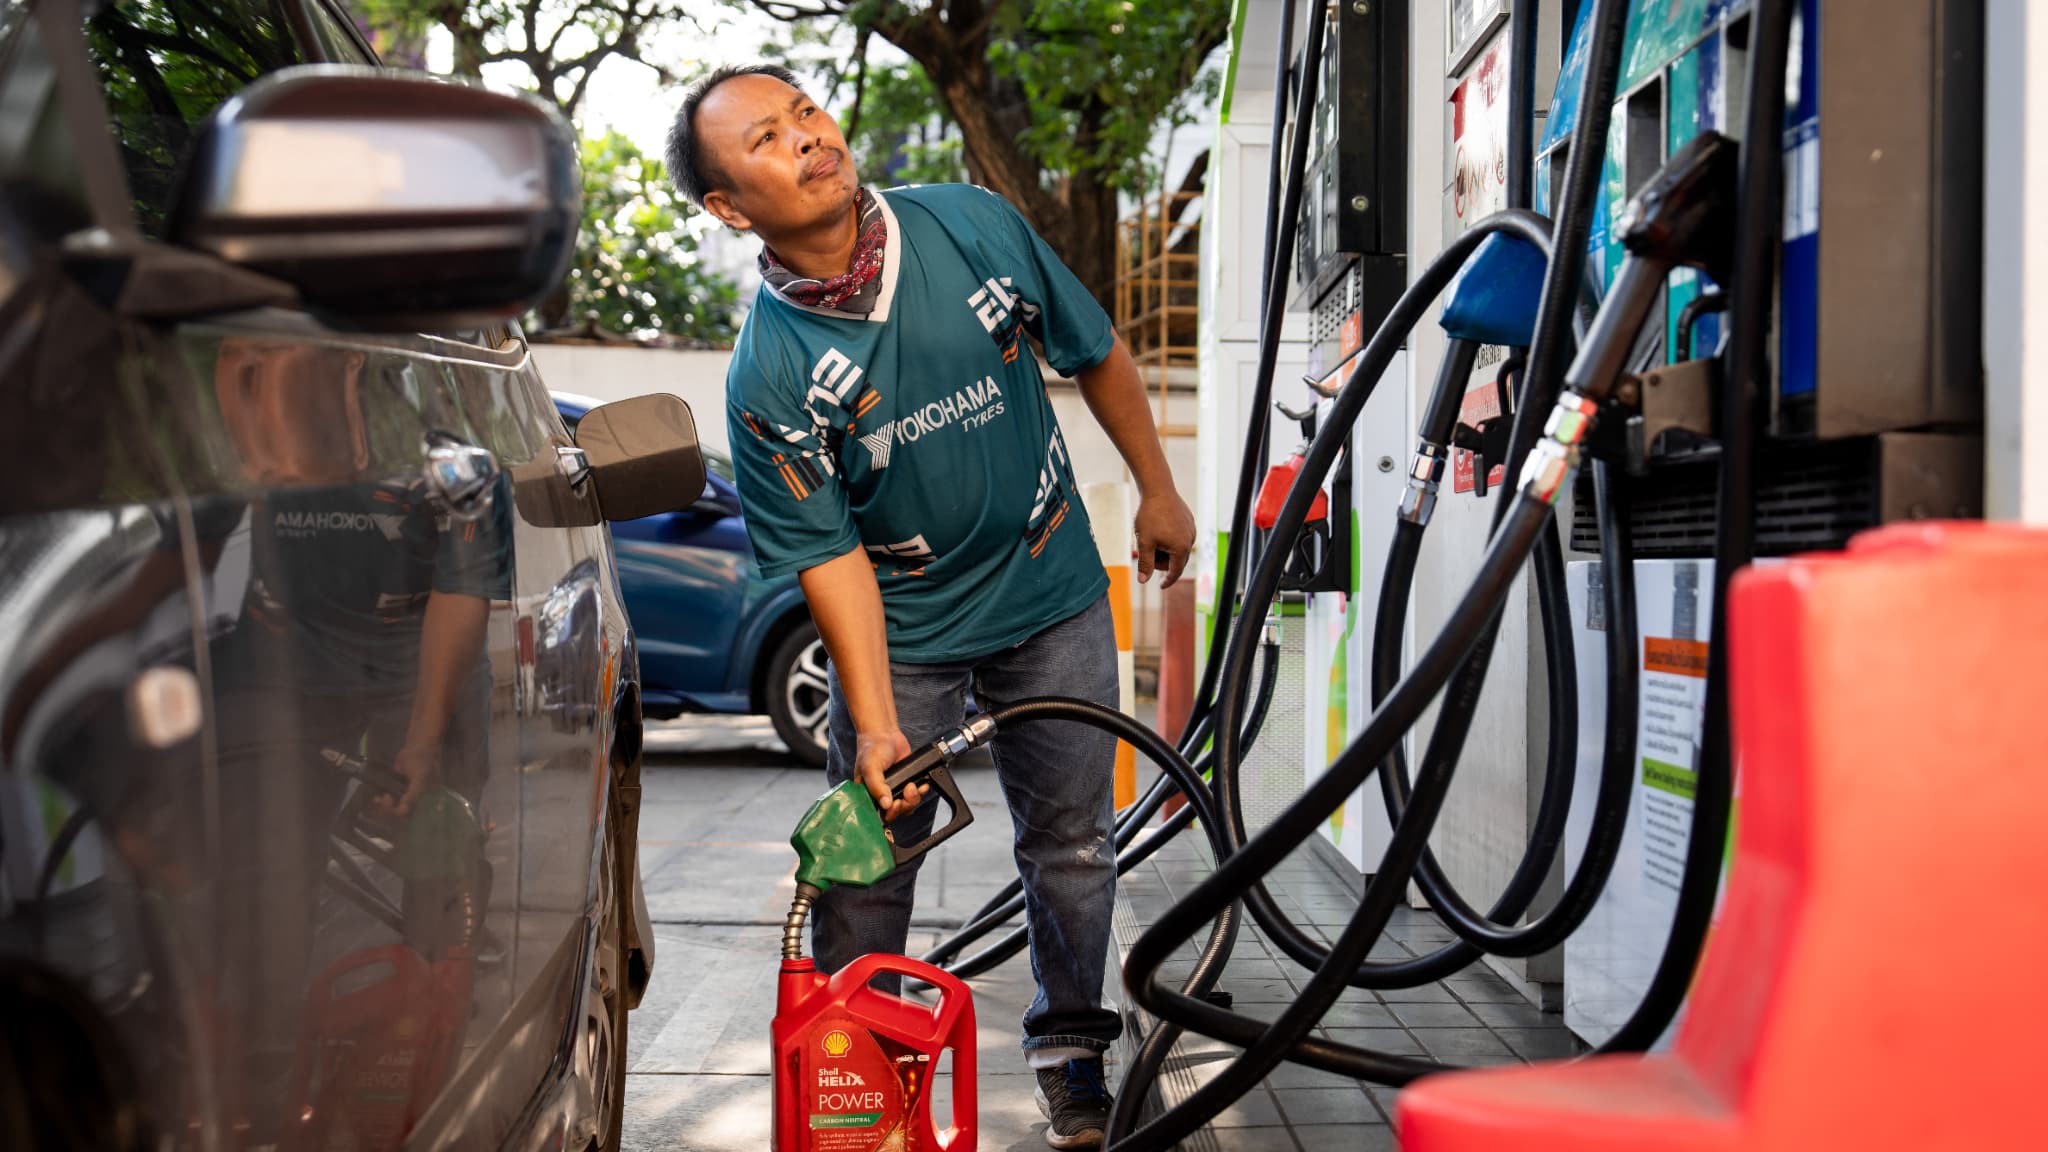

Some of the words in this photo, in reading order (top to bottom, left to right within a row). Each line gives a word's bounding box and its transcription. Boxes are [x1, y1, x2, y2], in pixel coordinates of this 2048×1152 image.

[894, 376, 1002, 445] YOKOHAMA
[962, 401, 1004, 432] TYRES
[818, 1068, 838, 1076] Shell
[818, 1073, 865, 1087] HELIX
[819, 1092, 884, 1111] POWER
